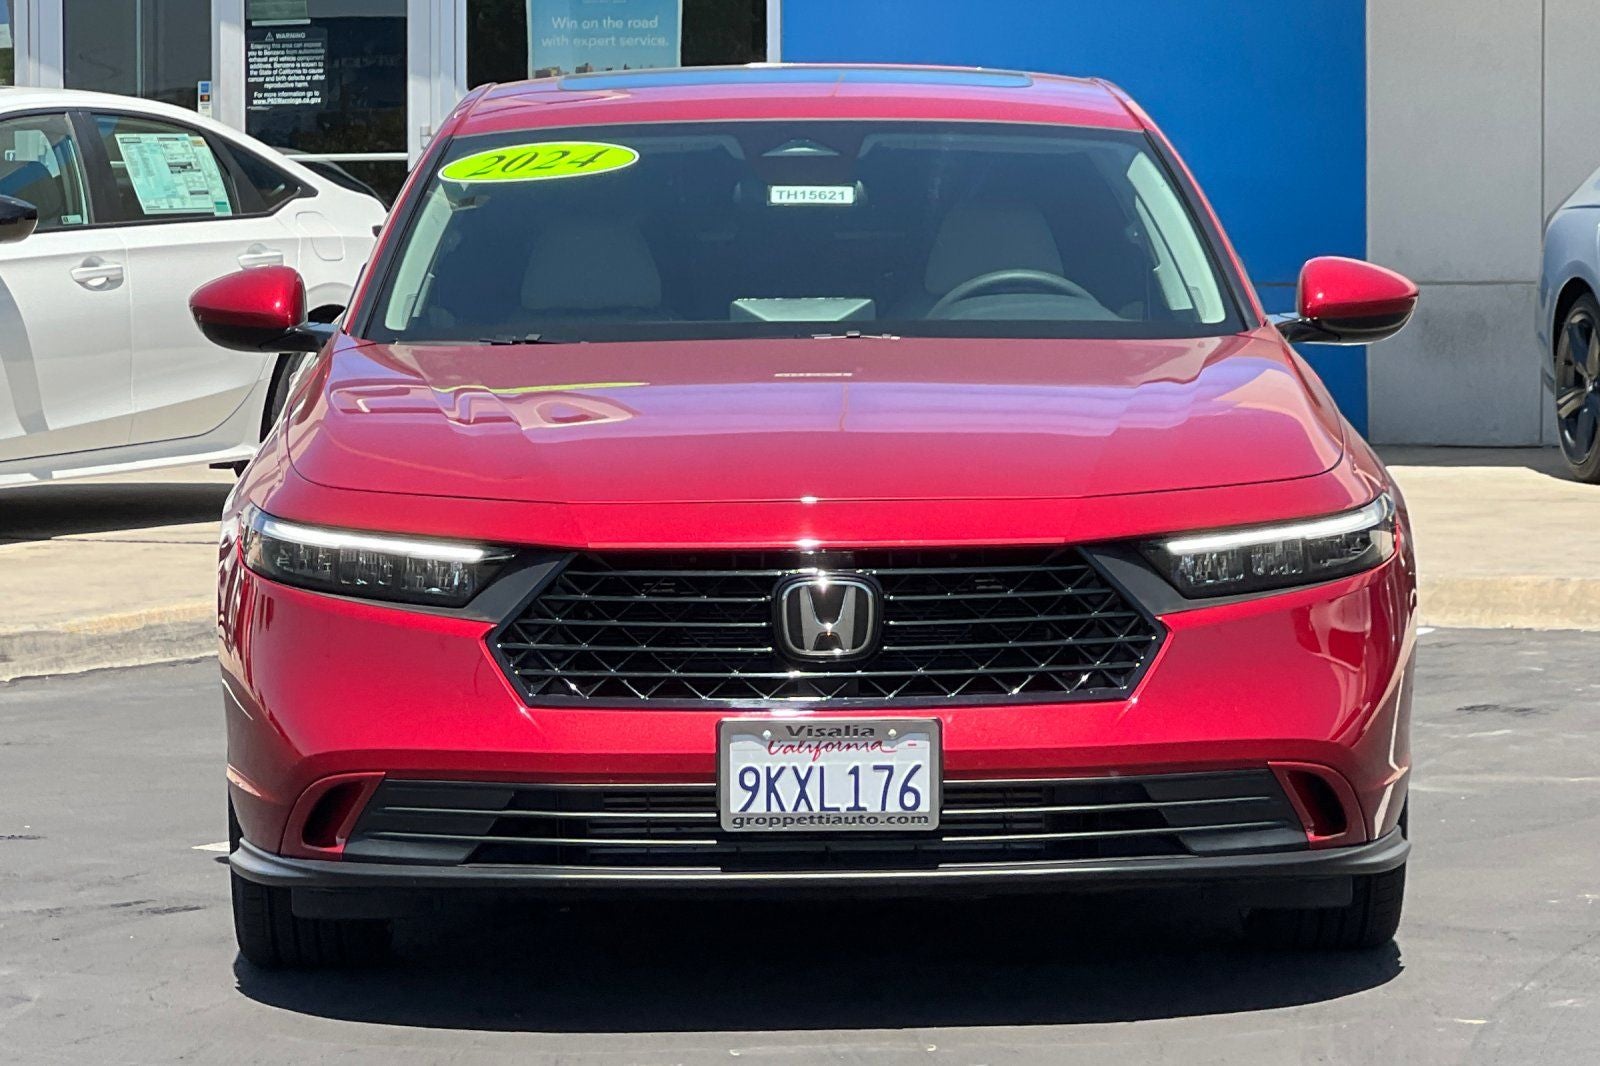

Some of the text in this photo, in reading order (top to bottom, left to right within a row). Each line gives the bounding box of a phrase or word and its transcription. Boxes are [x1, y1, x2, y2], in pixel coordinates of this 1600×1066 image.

[552, 15, 658, 29] Win on the road
[541, 35, 669, 49] with expert service.
[465, 149, 610, 177] 2024
[776, 190, 845, 200] TH15621
[786, 726, 875, 738] Visalia
[767, 740, 898, 762] California
[738, 764, 922, 812] 9KXL176
[732, 814, 929, 829] groppettiauto.com
